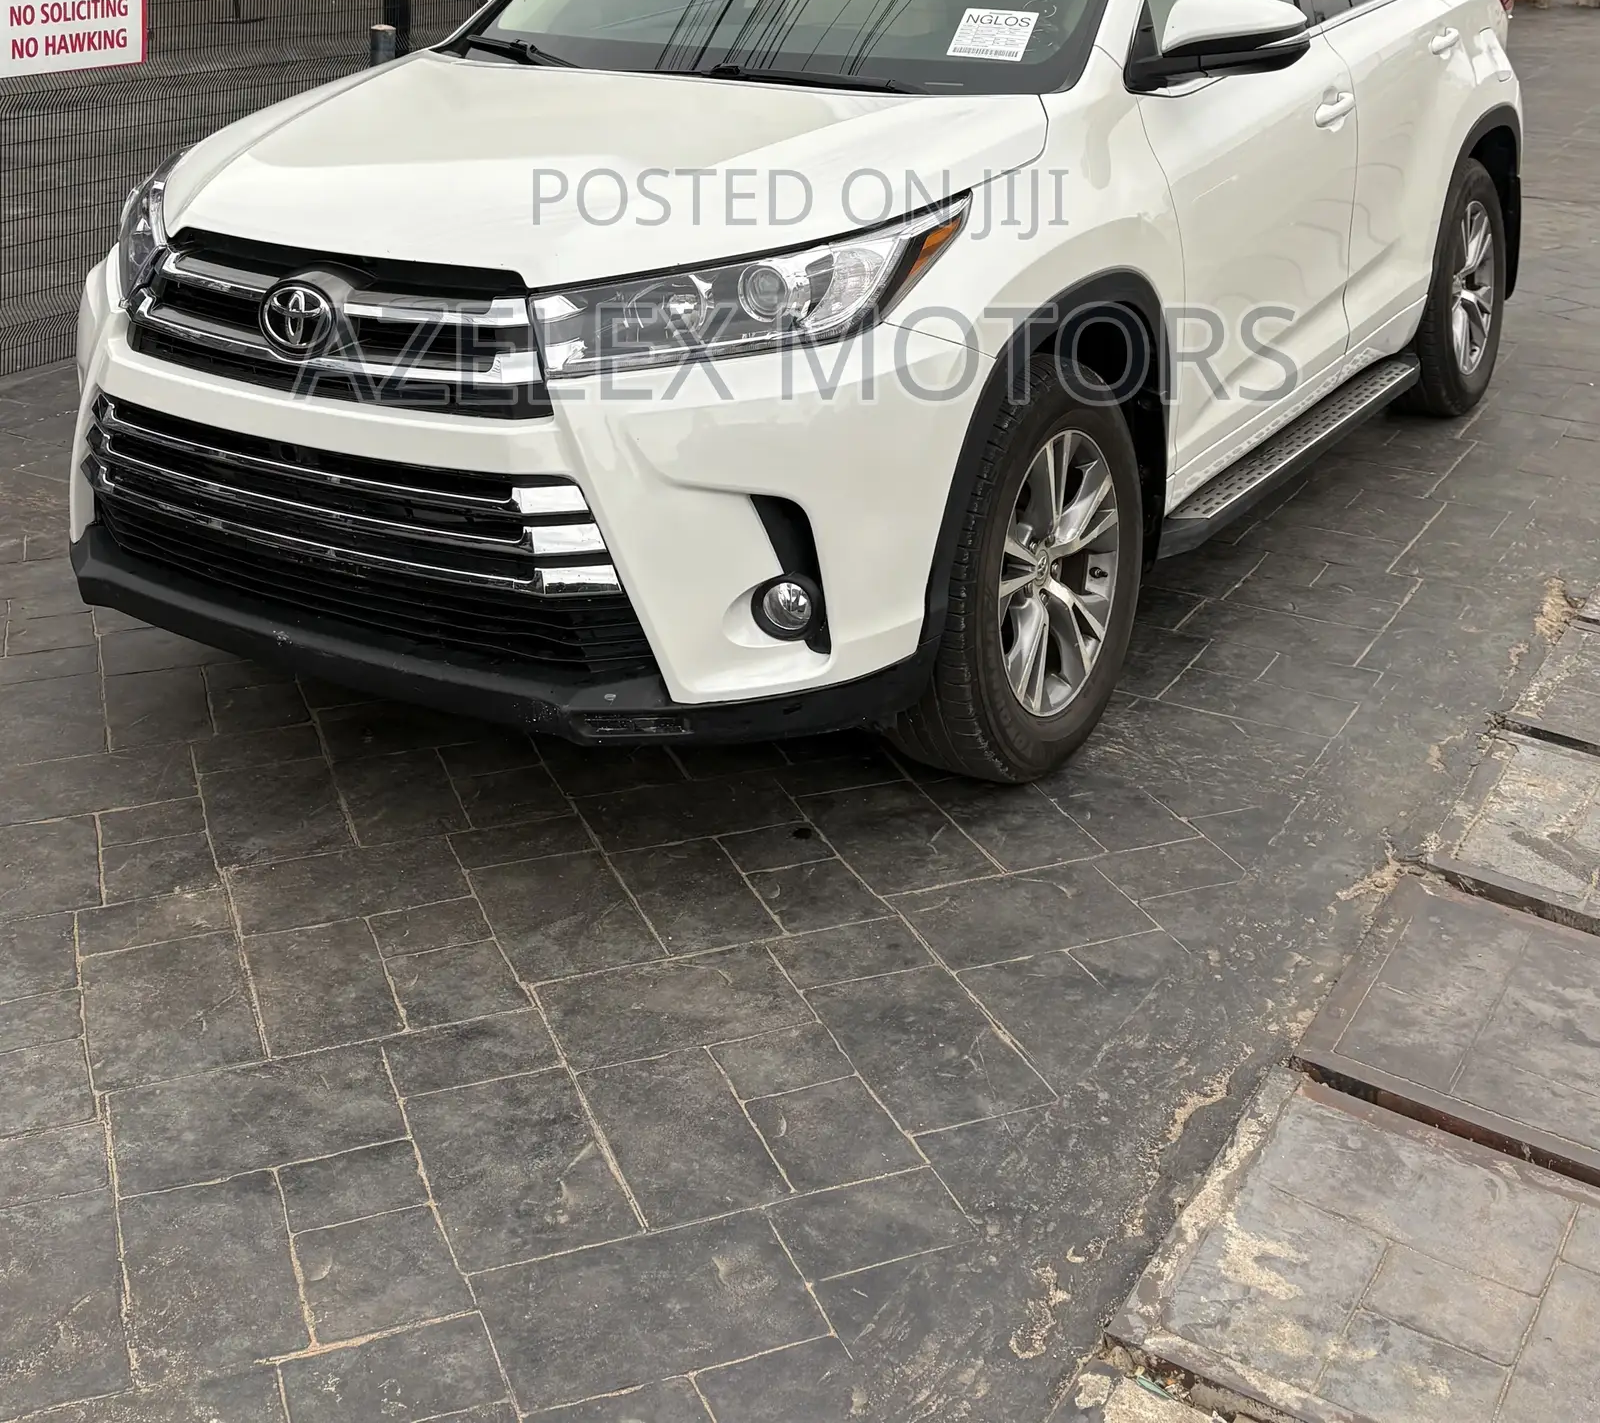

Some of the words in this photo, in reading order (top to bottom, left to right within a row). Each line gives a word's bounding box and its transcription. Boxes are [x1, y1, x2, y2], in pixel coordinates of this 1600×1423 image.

[9, 4, 36, 27] NO
[966, 13, 1031, 28] NGLOS
[11, 37, 39, 60] NO
[44, 28, 128, 56] HAWKING
